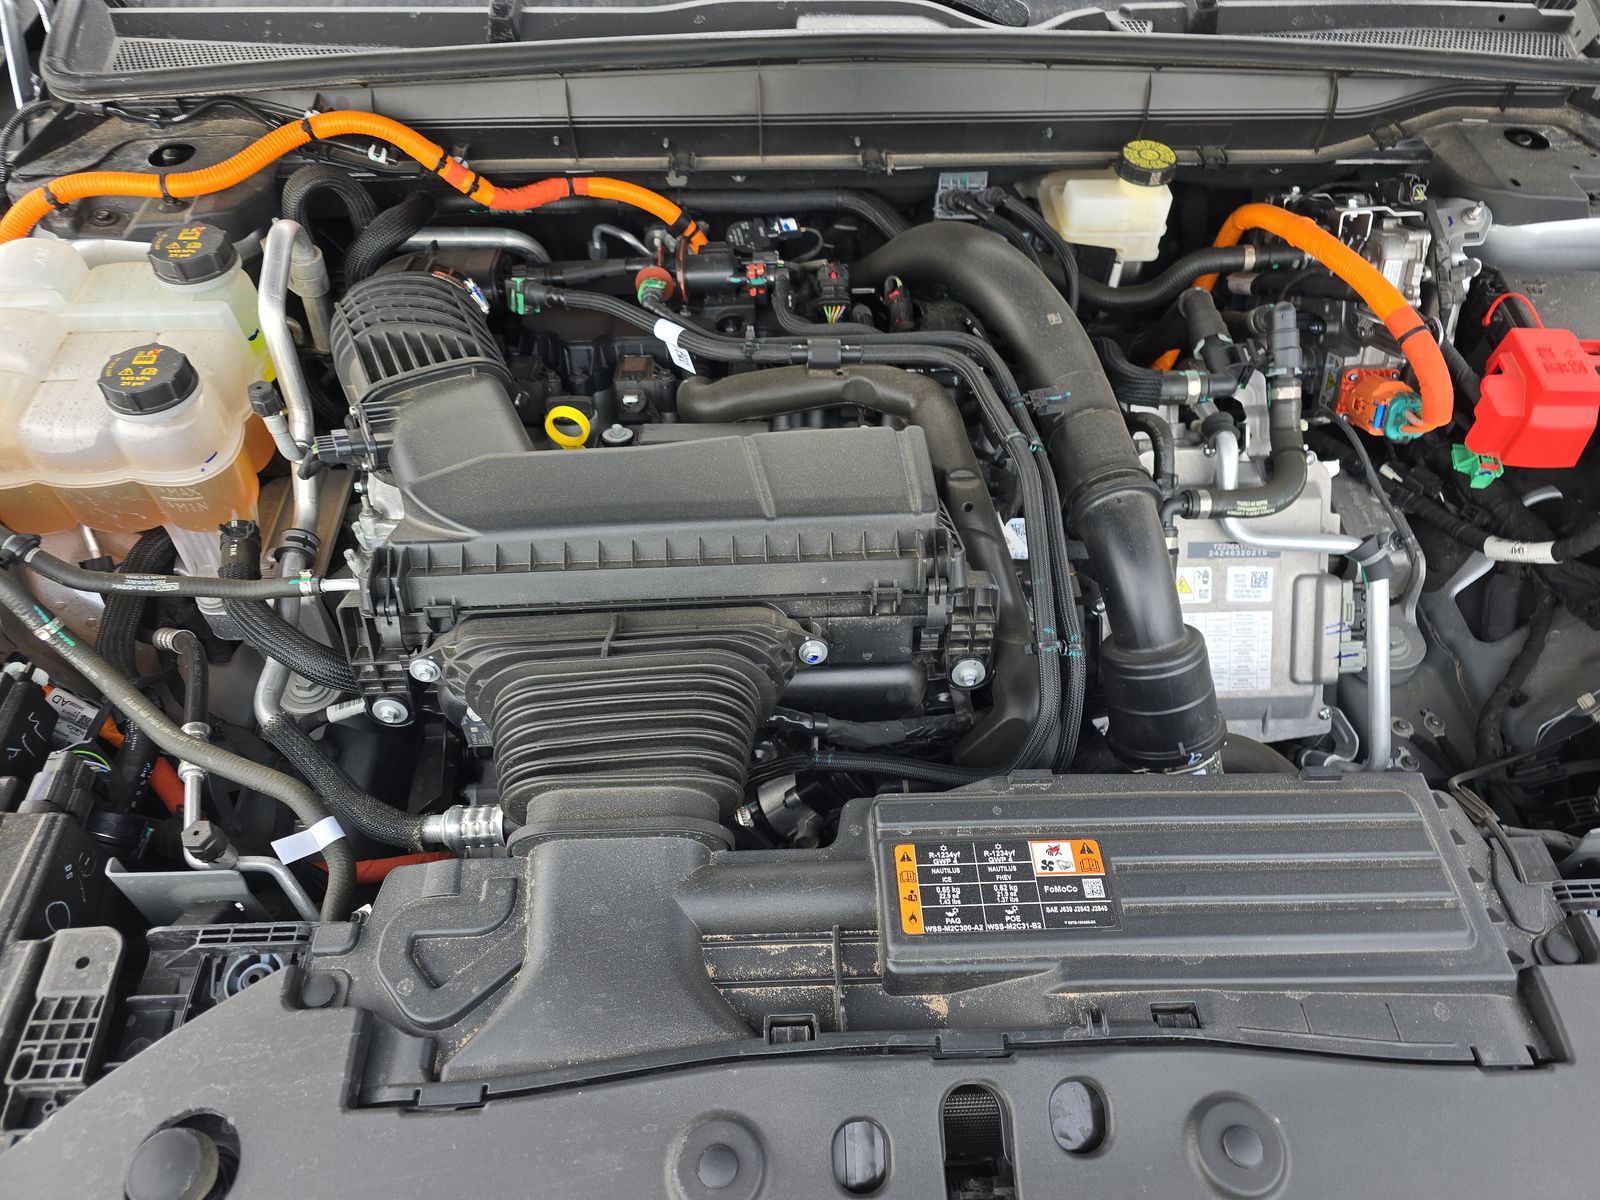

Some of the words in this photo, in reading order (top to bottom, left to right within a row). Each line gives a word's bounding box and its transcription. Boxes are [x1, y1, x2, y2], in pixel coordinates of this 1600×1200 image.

[51, 694, 70, 707] AD
[928, 851, 961, 860] R-1234yf
[983, 849, 1016, 859] R-1234yf
[932, 858, 951, 866] GWP
[931, 867, 961, 875] NAUTILUS
[987, 865, 1018, 873] NAUTILUS
[935, 886, 951, 894] 0.65
[951, 886, 961, 895] kg
[1008, 884, 1019, 893] kg
[1043, 885, 1079, 894] FoMoCo
[945, 917, 961, 925] PAG
[1004, 915, 1022, 923] POE
[924, 924, 984, 933] WSS-M2C300-A2
[987, 922, 1042, 931] WSS-M2C31-B2
